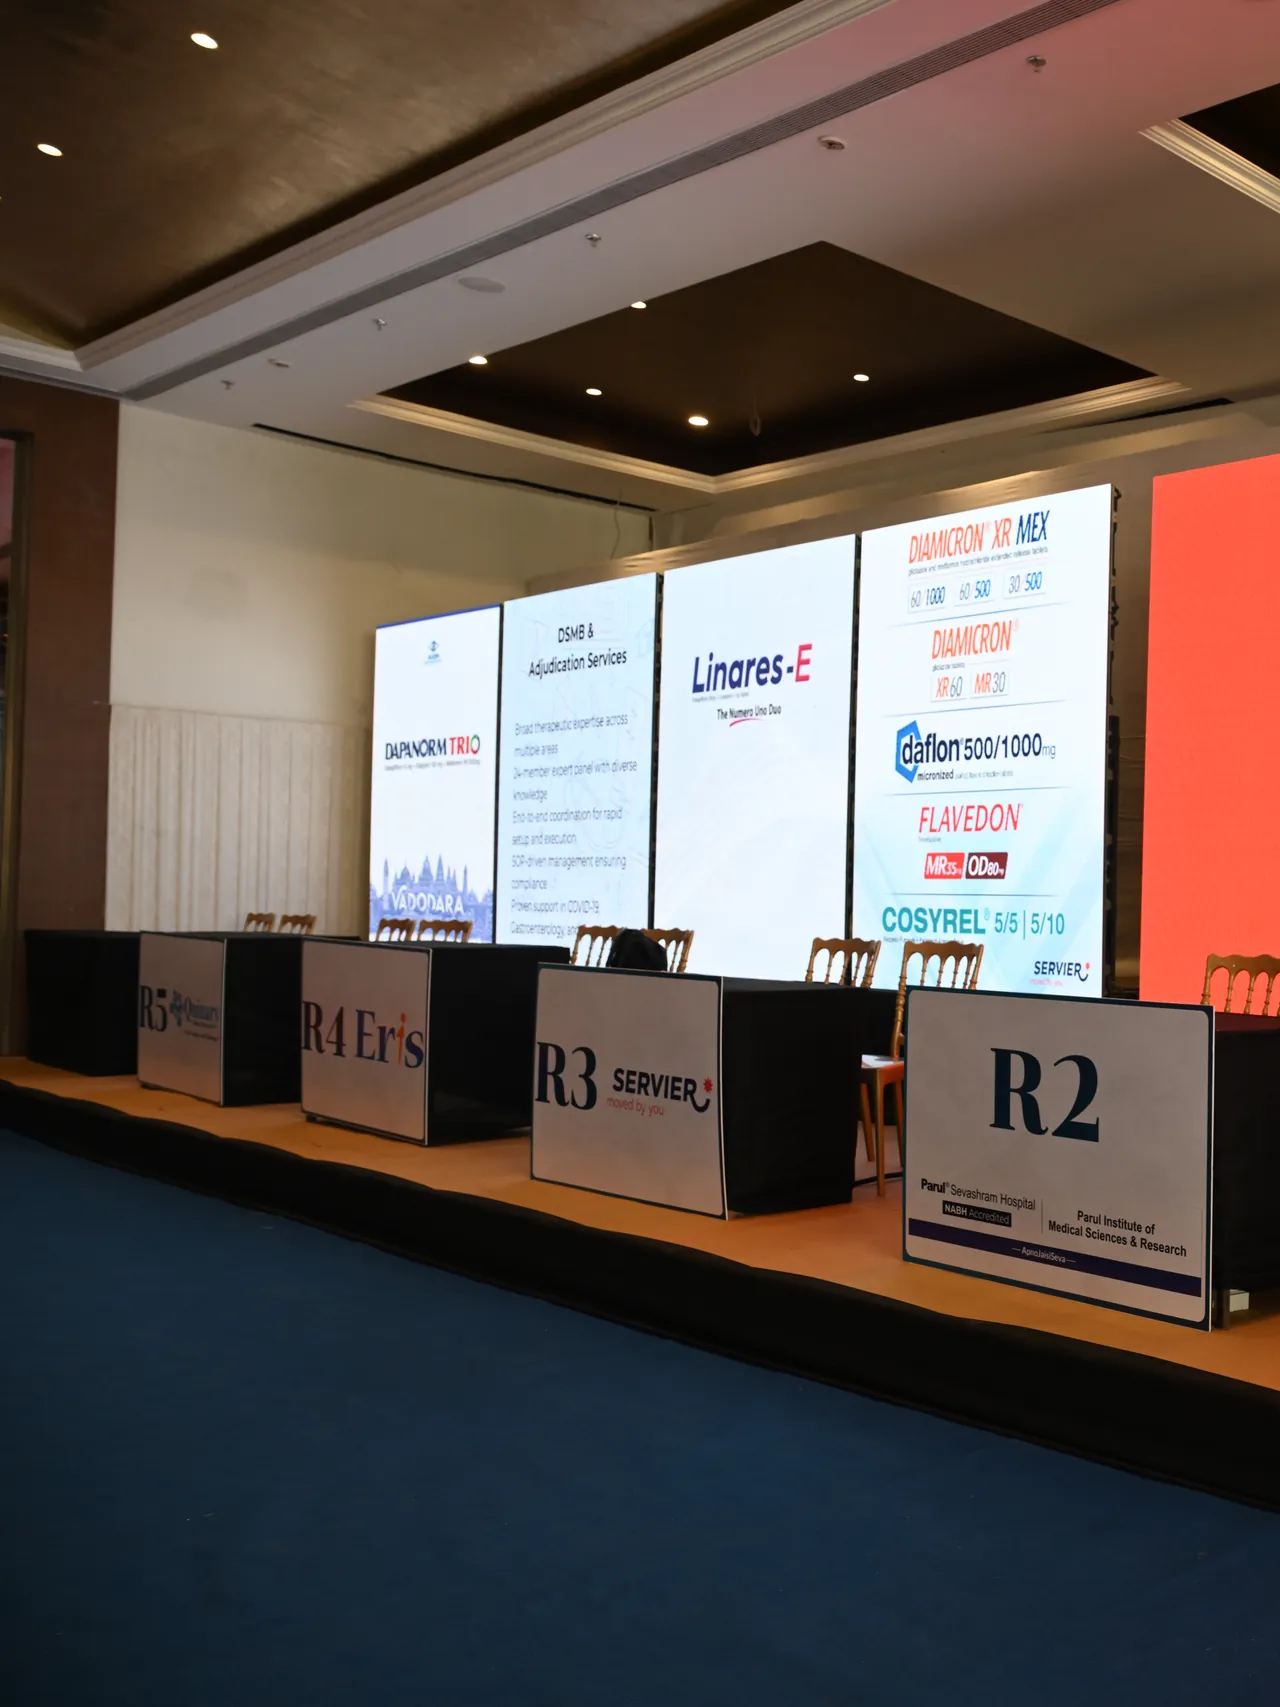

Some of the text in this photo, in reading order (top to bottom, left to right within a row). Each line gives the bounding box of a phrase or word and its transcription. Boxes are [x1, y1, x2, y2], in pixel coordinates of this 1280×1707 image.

[991, 517, 1013, 550] XR
[1016, 510, 1050, 545] MEX
[558, 622, 594, 643] DSMB &
[528, 648, 627, 679] Adjudication Services
[692, 643, 813, 694] Linares-E
[573, 715, 604, 732] expertise
[605, 713, 628, 727] across
[717, 703, 782, 720] The Numero Uno Duo
[385, 734, 481, 760] DAPANORM TRIO
[541, 743, 558, 756] areas
[551, 763, 573, 778] expert
[574, 761, 593, 777] panel
[594, 760, 610, 774] with
[611, 758, 637, 773] diverse
[917, 769, 954, 782] micronized
[592, 807, 602, 820] for
[603, 806, 623, 822] rapid
[548, 856, 593, 870] management
[994, 911, 1018, 934] 5/5
[1030, 912, 1065, 935] 5/10
[1033, 960, 1089, 982] SERVIER
[139, 985, 167, 1032] R5
[301, 1000, 424, 1069] R4 Eris
[535, 1041, 711, 1113] R3 SERVIER
[606, 1096, 664, 1117] moved by you
[989, 1047, 1100, 1143] R2
[950, 1184, 998, 1204] Sevashram
[1000, 1192, 1036, 1211] Hospital
[944, 1203, 1010, 1225] NABH Accredited
[1077, 1210, 1156, 1236] Parul Institute of
[1048, 1219, 1187, 1258] Medical Sciences & Research
